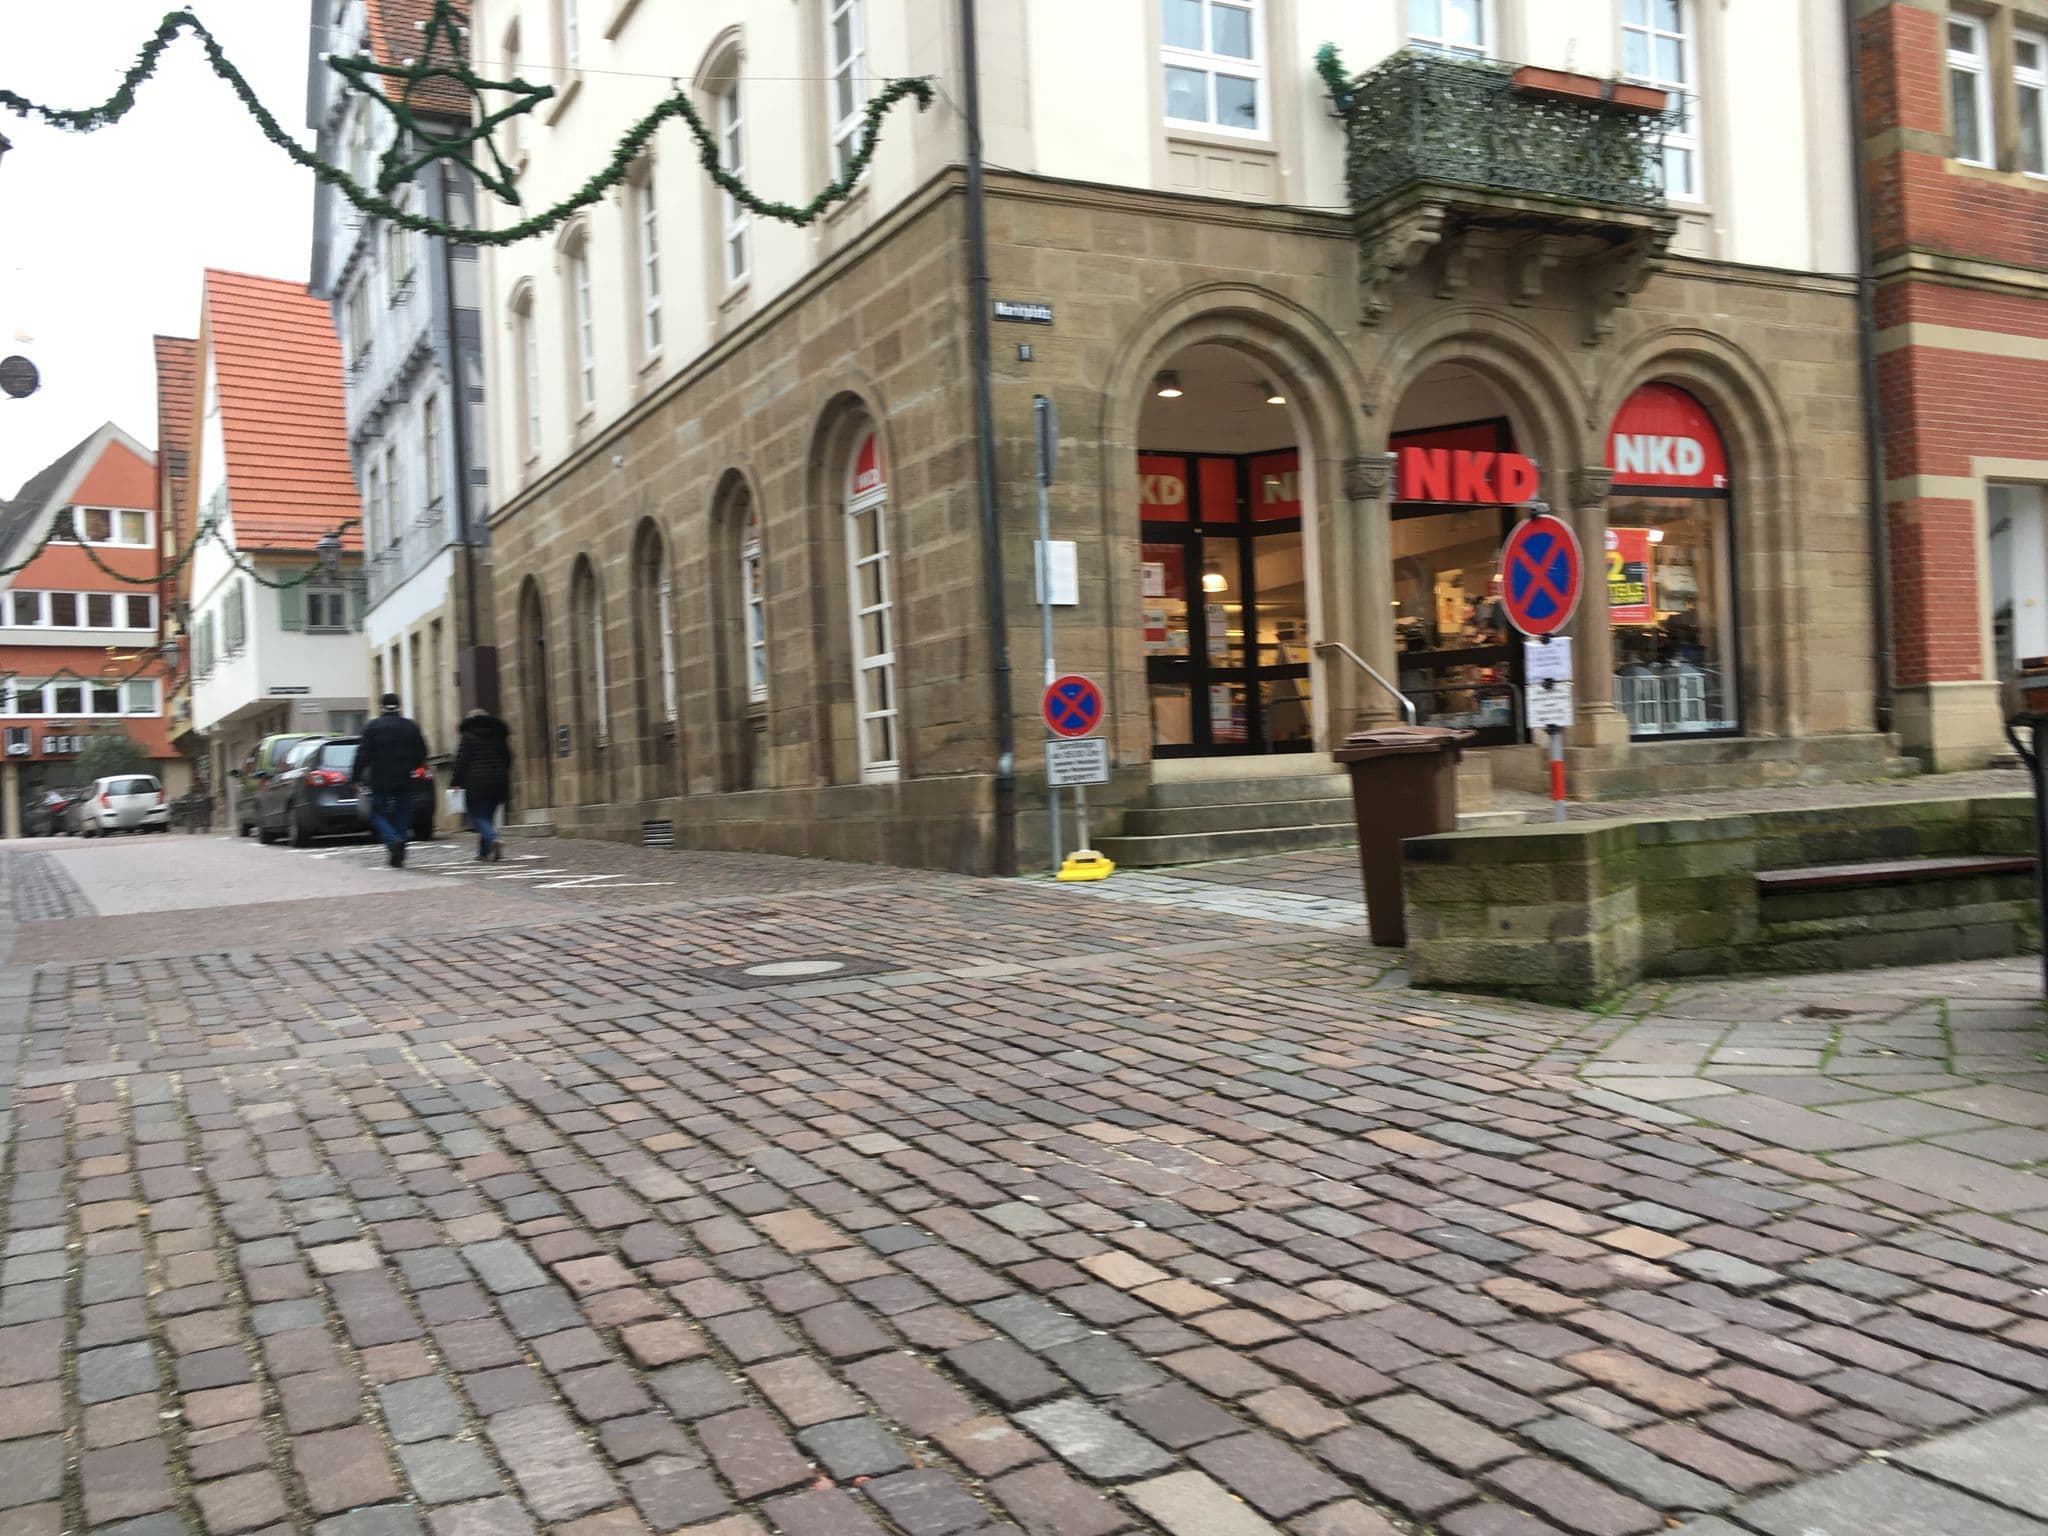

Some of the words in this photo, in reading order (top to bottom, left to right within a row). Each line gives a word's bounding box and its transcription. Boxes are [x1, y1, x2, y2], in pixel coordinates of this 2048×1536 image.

[1405, 447, 1540, 503] NKD
[1613, 433, 1705, 475] NKD
[1605, 551, 1626, 580] 2
